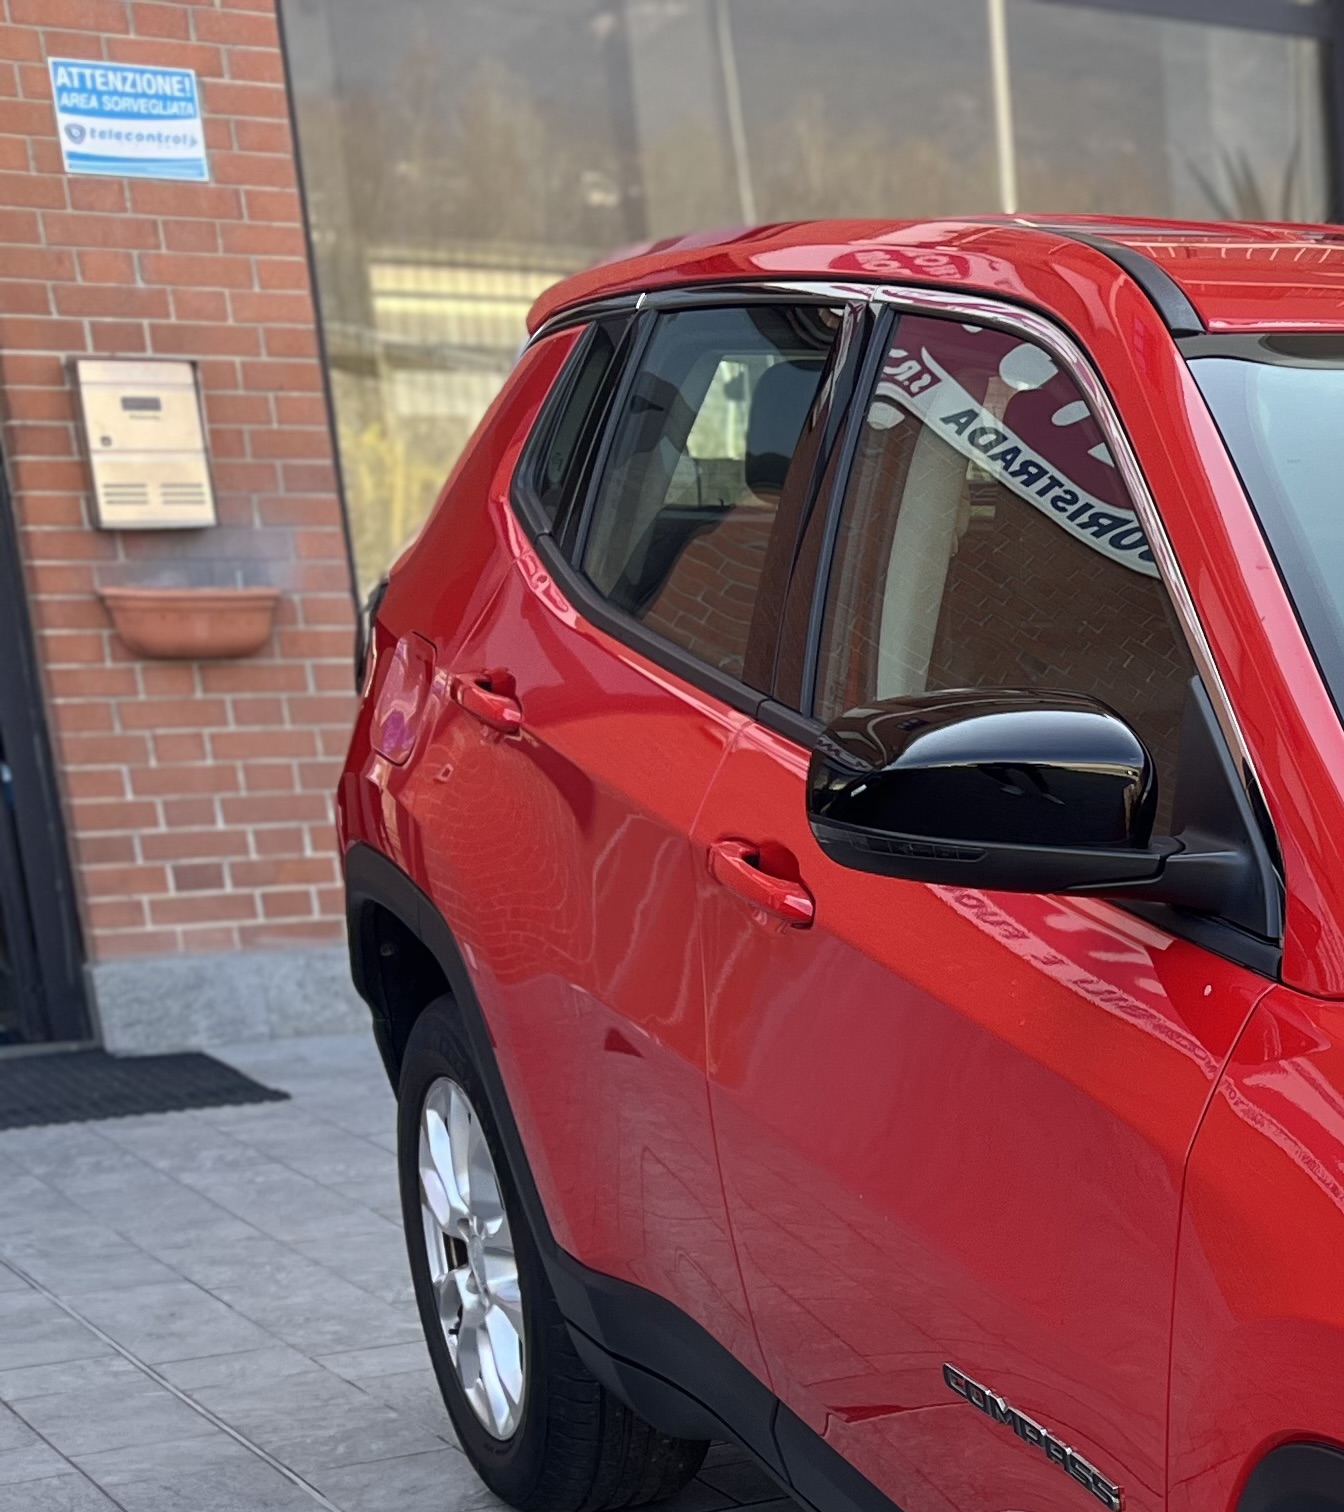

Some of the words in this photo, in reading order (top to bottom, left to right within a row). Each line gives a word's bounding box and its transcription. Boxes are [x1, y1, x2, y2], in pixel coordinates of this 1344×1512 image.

[56, 66, 192, 97] ATTENZIONE!
[60, 92, 99, 110] AREA
[102, 95, 195, 116] SORVEGLIATA
[90, 127, 188, 145] telecontrol
